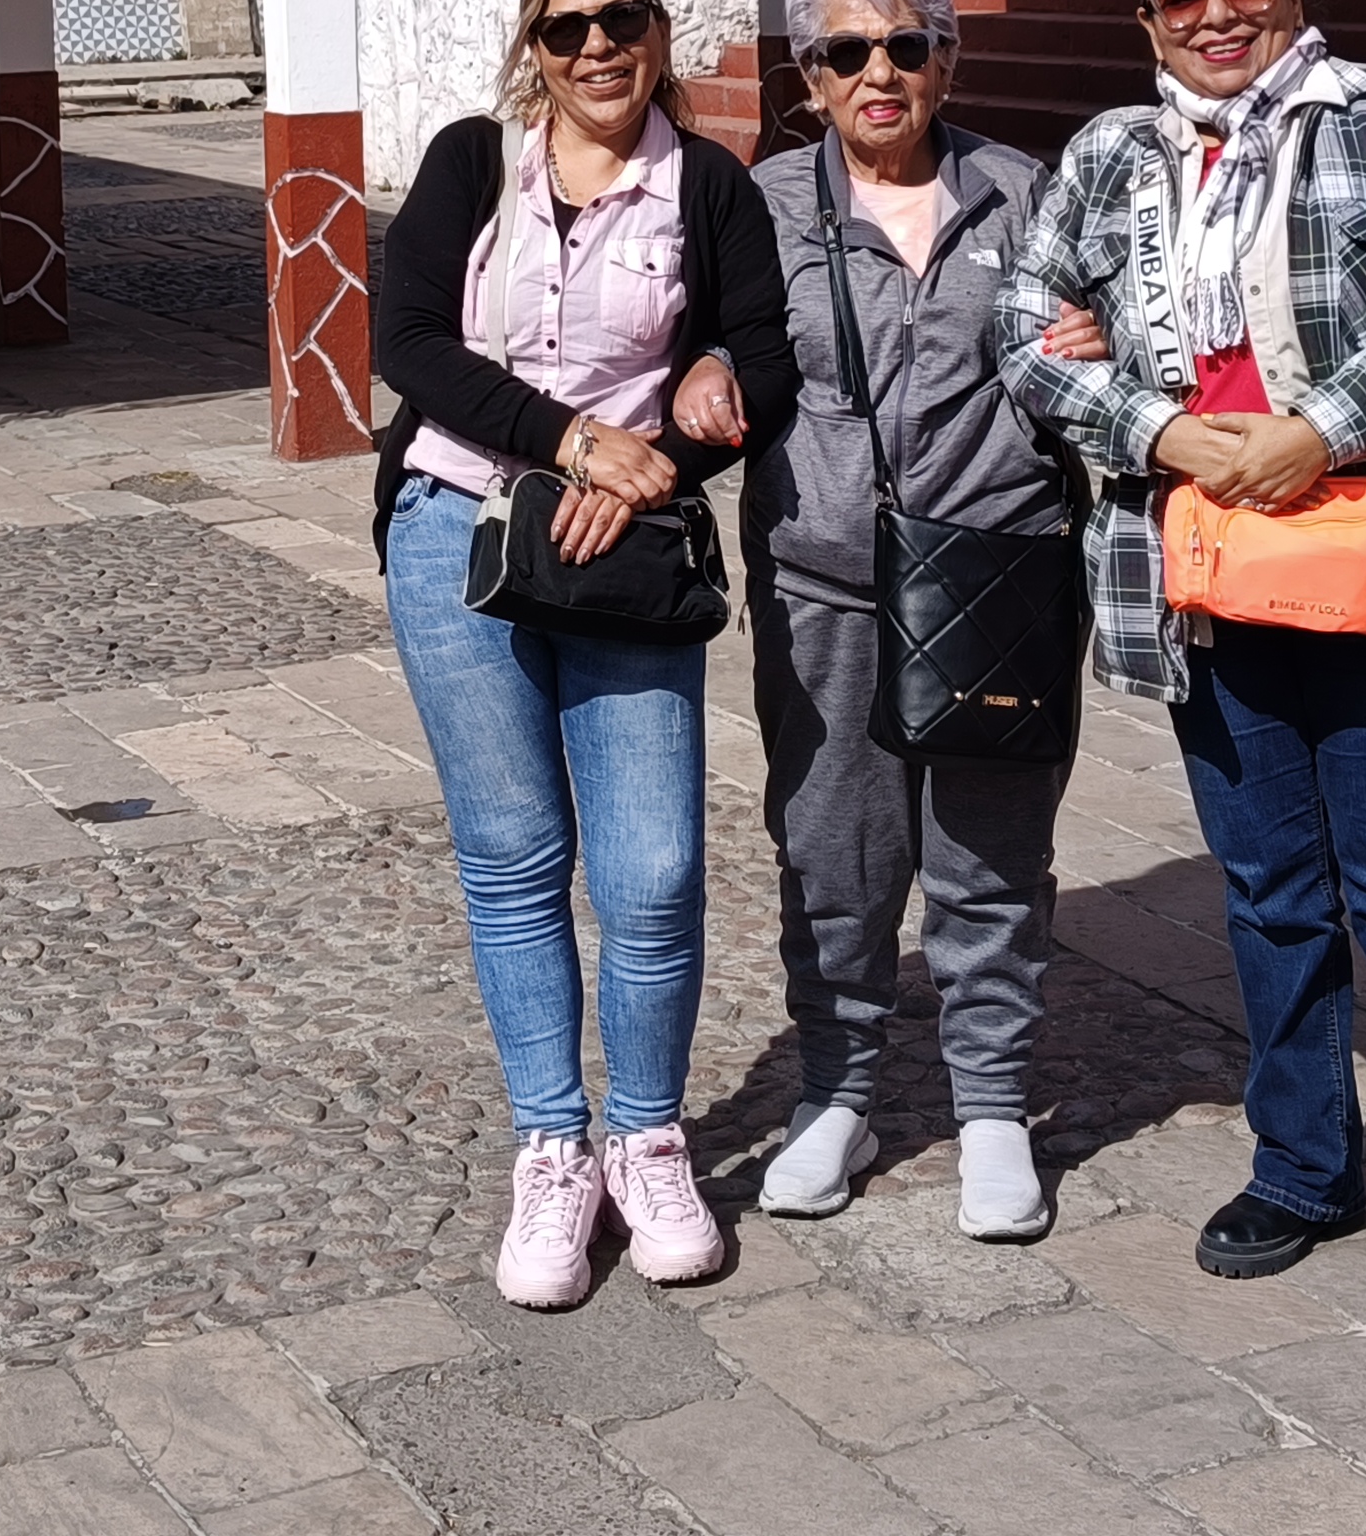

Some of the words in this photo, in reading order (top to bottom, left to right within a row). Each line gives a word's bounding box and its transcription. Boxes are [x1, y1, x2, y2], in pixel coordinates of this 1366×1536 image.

[1137, 205, 1168, 307] BIMBA
[1149, 309, 1175, 334] Y
[1318, 604, 1349, 617] LOLA
